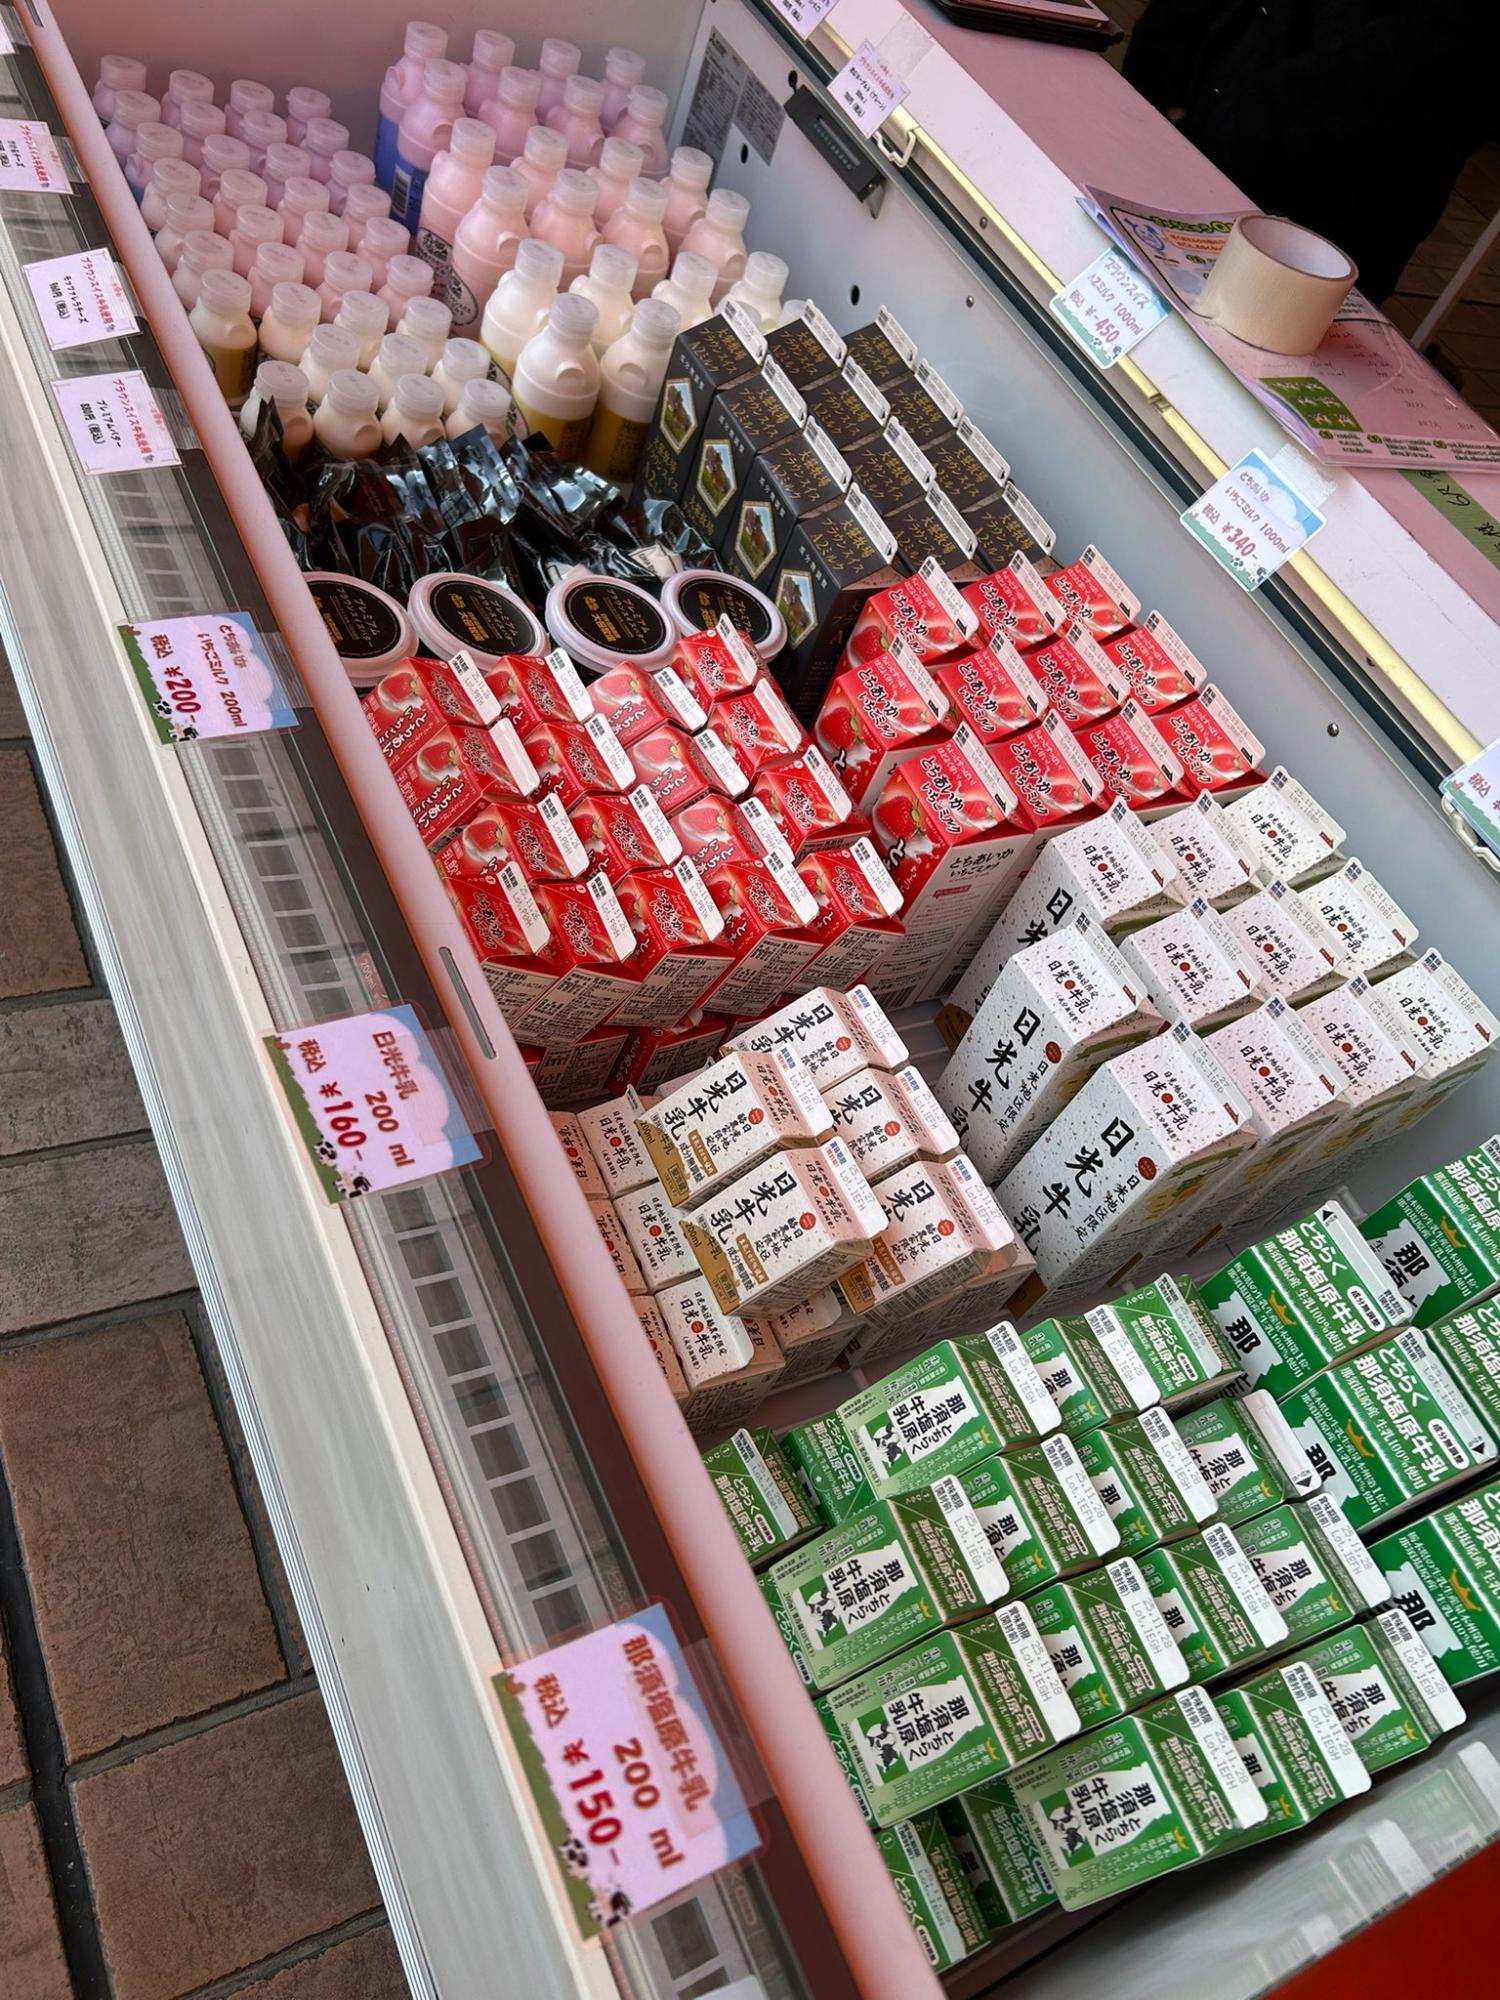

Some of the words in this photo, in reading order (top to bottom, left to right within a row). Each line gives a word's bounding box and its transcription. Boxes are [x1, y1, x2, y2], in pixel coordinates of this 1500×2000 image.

[62, 275, 88, 323] モッツァレラチーズ
[79, 256, 113, 325] ブラウンスイス牛乳使用
[1068, 288, 1086, 308] 税込
[1086, 271, 1115, 303] A2ミルク
[1112, 302, 1144, 335] 1000ml
[1101, 255, 1150, 309] ブラウンスイス
[698, 326, 737, 374] ブラウンスイス
[96, 399, 122, 447] プレミアムバター
[111, 378, 152, 453] ブラウンスイス牛乳使用
[738, 387, 779, 438] ブラウンスイス
[779, 447, 820, 502] ブラウンスイス
[1200, 502, 1221, 524] 税込
[1223, 485, 1260, 523] いちごミルク
[1258, 521, 1290, 554] 1000ml
[820, 517, 864, 574] ブラウンスイス
[888, 587, 928, 638] とちあいか
[978, 579, 1019, 627] とちあいか
[1052, 574, 1094, 621] とちあいか
[150, 633, 173, 659] 税込
[218, 623, 248, 669] とちあいか
[888, 610, 926, 657] いちごミルク
[197, 633, 228, 685] いちごミルク
[219, 690, 247, 727] 200ml
[956, 660, 998, 714] とちあいか
[1035, 652, 1080, 702] とちあいか
[1115, 640, 1157, 688] とちあいか
[1115, 663, 1155, 707] いちごミルク
[856, 666, 899, 719] とちあいか
[856, 691, 896, 739] いちごミルク
[956, 686, 994, 734] いちごミルク
[1038, 677, 1078, 721] いちごミルク
[1168, 712, 1214, 765] とちあいか
[1168, 738, 1212, 785] いちごミルク
[1008, 740, 1052, 796] とちあいか
[1008, 766, 1048, 817] いちごミルク
[1089, 754, 1132, 802] いちごミルク
[1466, 770, 1493, 798] 税込
[919, 783, 962, 833] いちごミルク
[1167, 834, 1209, 883] 日光牛乳
[1248, 812, 1293, 859] 日光牛乳
[1243, 923, 1291, 976] 日光牛乳
[1318, 903, 1363, 954] 日光牛乳
[1396, 994, 1446, 1050] 日光牛乳
[297, 1038, 327, 1073] 税込
[372, 1030, 419, 1101] 日光牛乳
[1320, 1020, 1370, 1077] 日光牛乳
[364, 1089, 400, 1134] 200
[388, 1143, 415, 1167] ml
[661, 1067, 751, 1141] 日光牛乳
[637, 1119, 657, 1146] 200ml
[708, 1169, 800, 1245] 日光牛乳
[1012, 1117, 1135, 1255] 日光牛乳
[683, 1221, 703, 1248] 200ml
[724, 1245, 755, 1293] 成分無調整
[1275, 1226, 1367, 1346] 那須塩原牛乳
[1298, 1217, 1347, 1277] とちらく
[1349, 1288, 1381, 1328] 成分無調整
[995, 1324, 1017, 1354] 賞味期限
[977, 1358, 1024, 1436] 那須塩原牛乳
[990, 1364, 1017, 1404] とちらく
[1376, 1343, 1429, 1408] とちらく
[890, 1393, 927, 1425] 牛乳
[1148, 1408, 1172, 1439] 賞味期限
[1352, 1352, 1450, 1483] 那須塩原牛乳
[812, 1420, 857, 1496] 那須塩原牛乳
[824, 1416, 850, 1454] とちらく
[908, 1422, 955, 1456] とちらく
[941, 1477, 964, 1509] 賞味期限
[917, 1518, 969, 1607] 那須塩原牛乳
[932, 1525, 961, 1569] とちらく
[825, 1557, 865, 1591] 牛乳
[843, 1591, 892, 1625] とちらく
[1006, 1605, 1031, 1640] 賞味期限
[531, 1672, 571, 1729] 税込
[620, 1632, 713, 1812] 那須塩原牛乳
[885, 1690, 927, 1726] 牛乳
[981, 1651, 1037, 1748] 那須塩原牛乳
[905, 1728, 956, 1763] とちらく
[611, 1736, 662, 1812] 200
[647, 1827, 684, 1870] ml
[1069, 1774, 1111, 1810] 牛乳
[1165, 1736, 1225, 1836] 那須塩原牛乳
[990, 1806, 1043, 1902] 那須塩原牛乳
